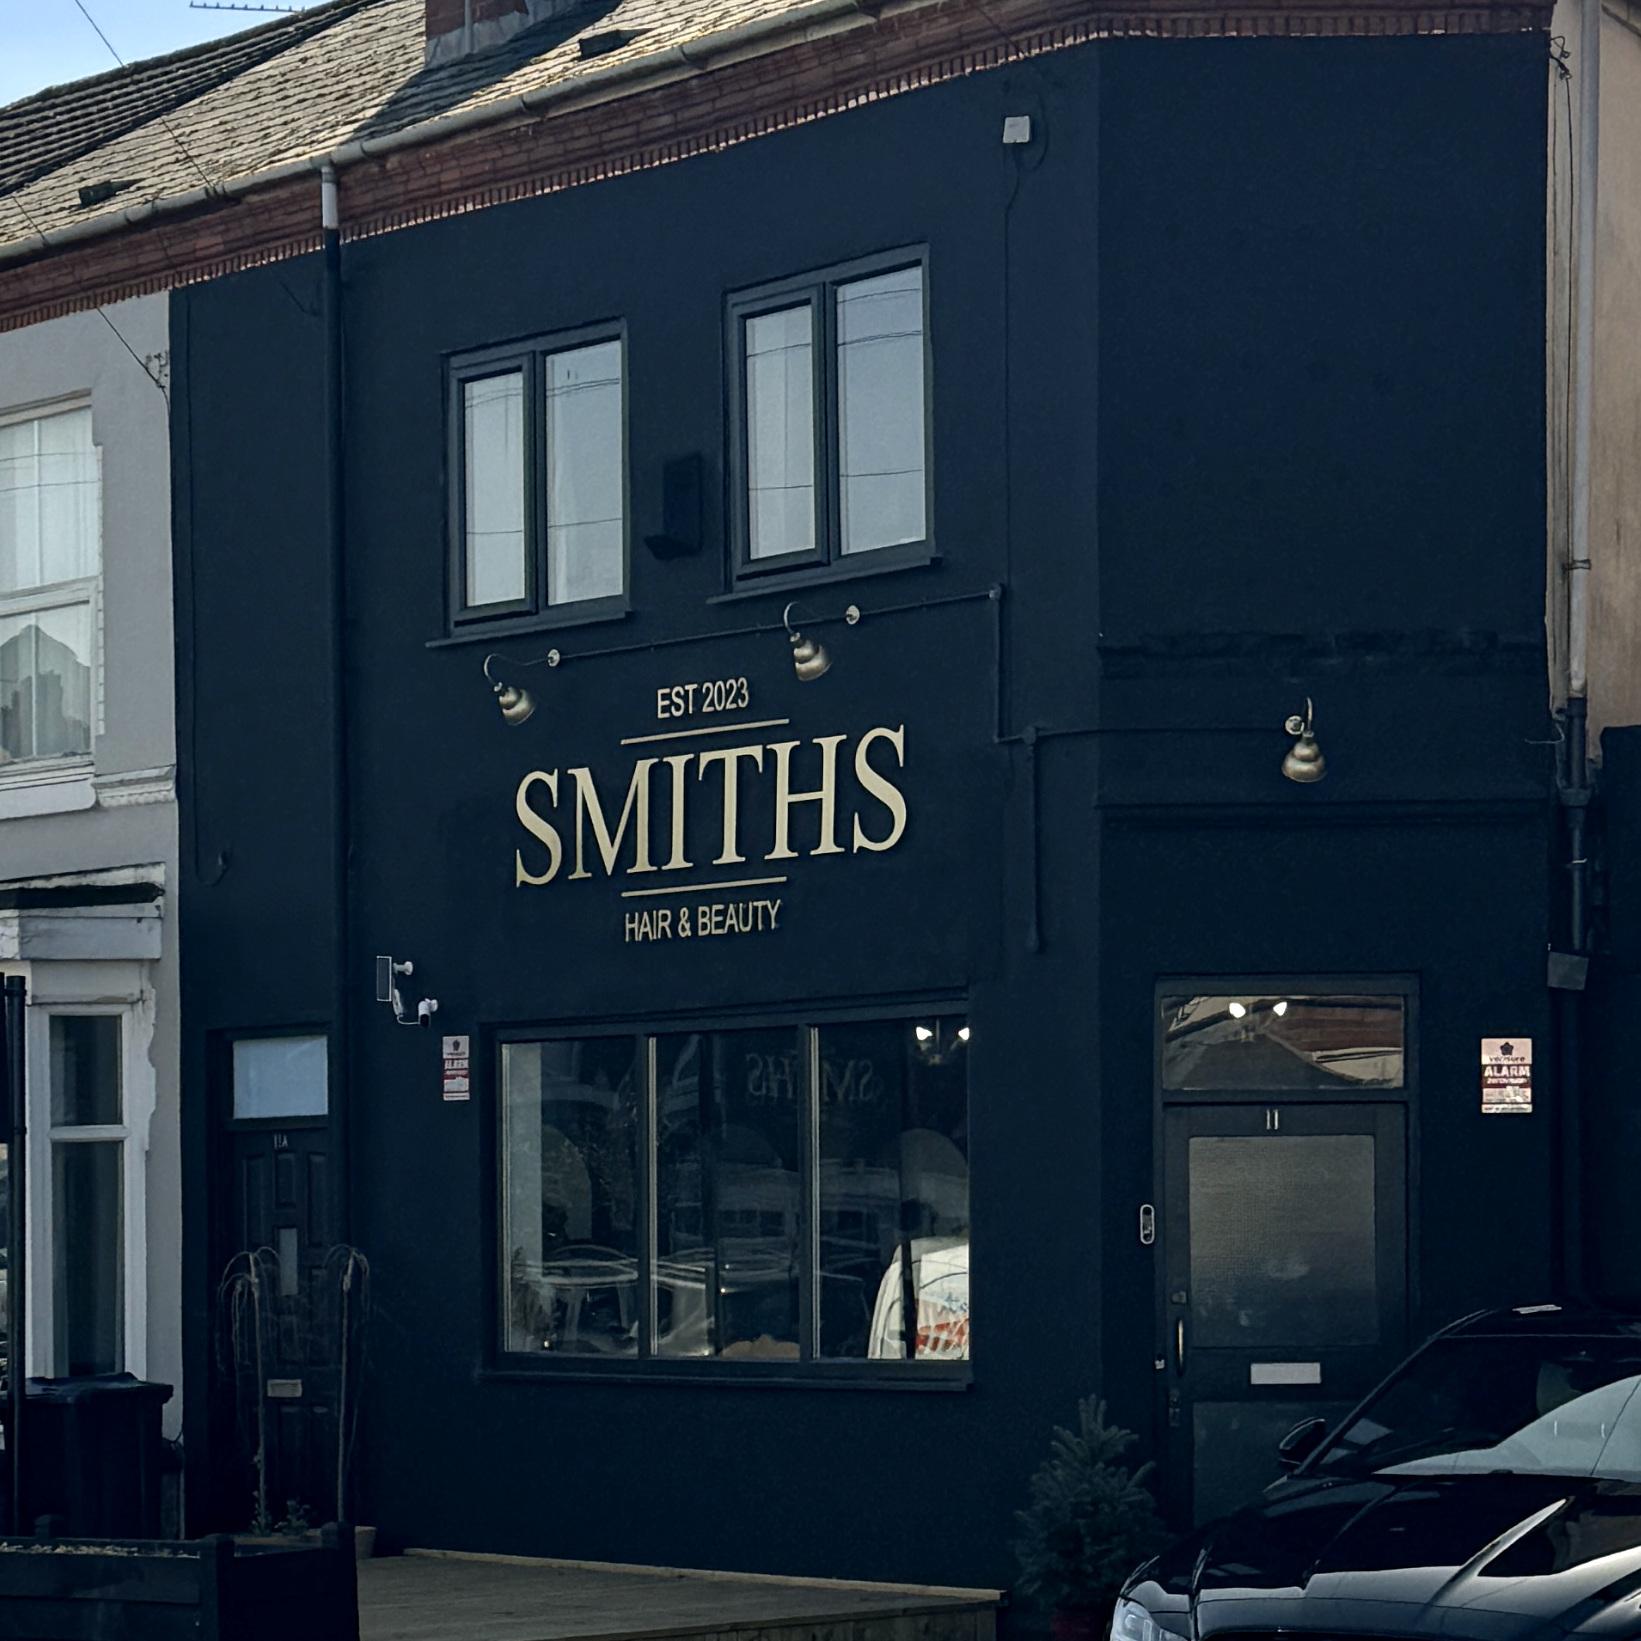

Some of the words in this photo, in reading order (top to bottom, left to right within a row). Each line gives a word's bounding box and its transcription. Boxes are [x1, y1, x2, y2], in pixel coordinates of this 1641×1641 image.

[656, 683, 698, 719] EST
[702, 677, 750, 713] 2023
[516, 724, 907, 888] SMITHS
[625, 908, 672, 942] HAIR
[677, 907, 692, 938] &
[698, 899, 782, 937] BEAUTY
[1484, 1065, 1531, 1077] ALARM
